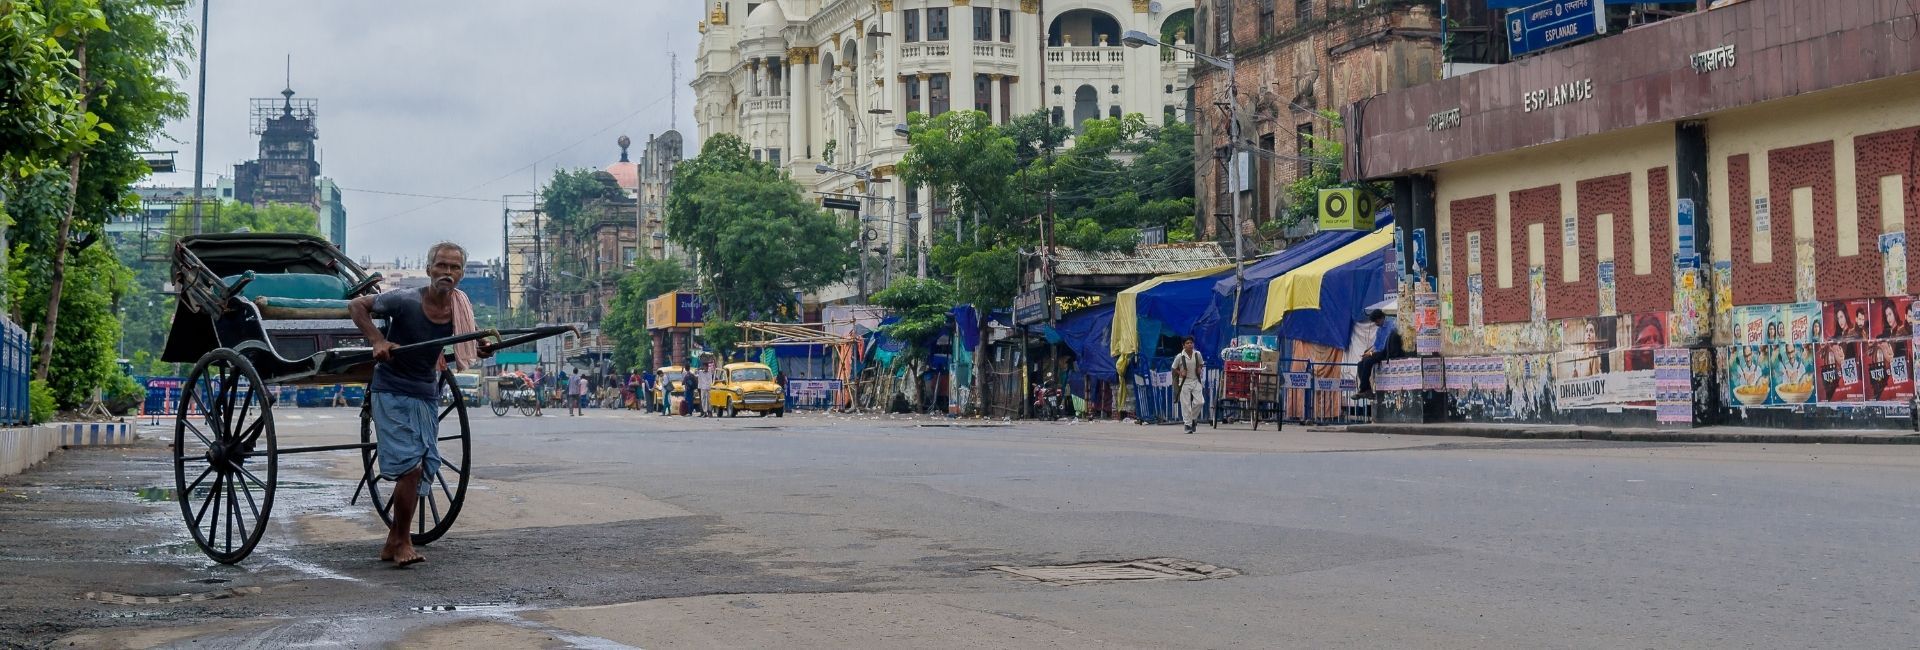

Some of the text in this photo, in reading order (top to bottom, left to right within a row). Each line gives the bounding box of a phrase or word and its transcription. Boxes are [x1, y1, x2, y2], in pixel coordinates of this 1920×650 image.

[1545, 23, 1578, 42] ESPLANADE
[1524, 78, 1593, 113] ESPLANADE
[1892, 362, 1904, 376] ছবি
[1560, 380, 1606, 398] DHANANJOY
